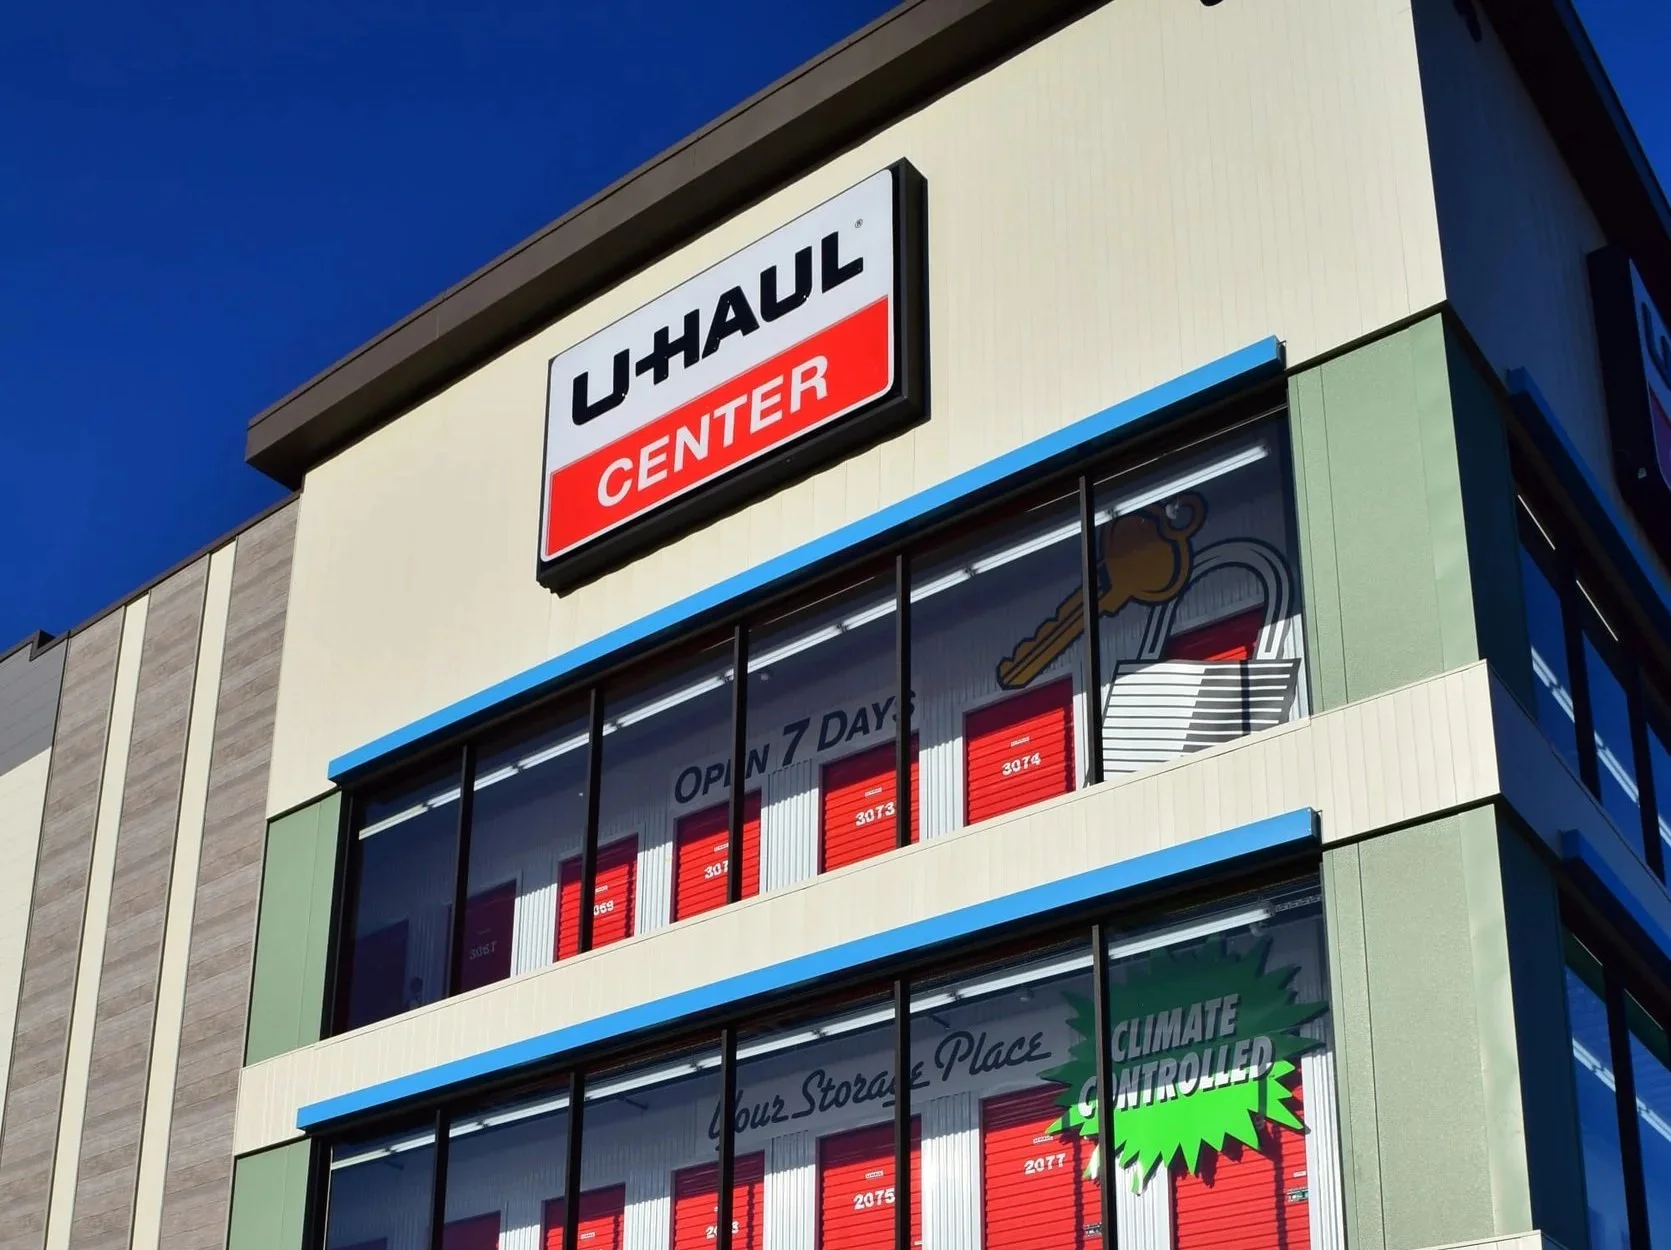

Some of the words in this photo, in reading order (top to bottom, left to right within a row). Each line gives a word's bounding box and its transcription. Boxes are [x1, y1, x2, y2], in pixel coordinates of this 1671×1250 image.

[572, 231, 864, 427] U-HAUL
[597, 354, 830, 508] CENTER
[782, 717, 811, 767] 7
[1002, 752, 1042, 776] 3074
[855, 801, 896, 827] 3073
[1110, 993, 1240, 1064] CLIMATE
[934, 1031, 1052, 1082] Place
[1077, 1035, 1273, 1119] CNTROLLED
[1024, 1153, 1067, 1175] 2077
[853, 1188, 896, 1211] 2075
